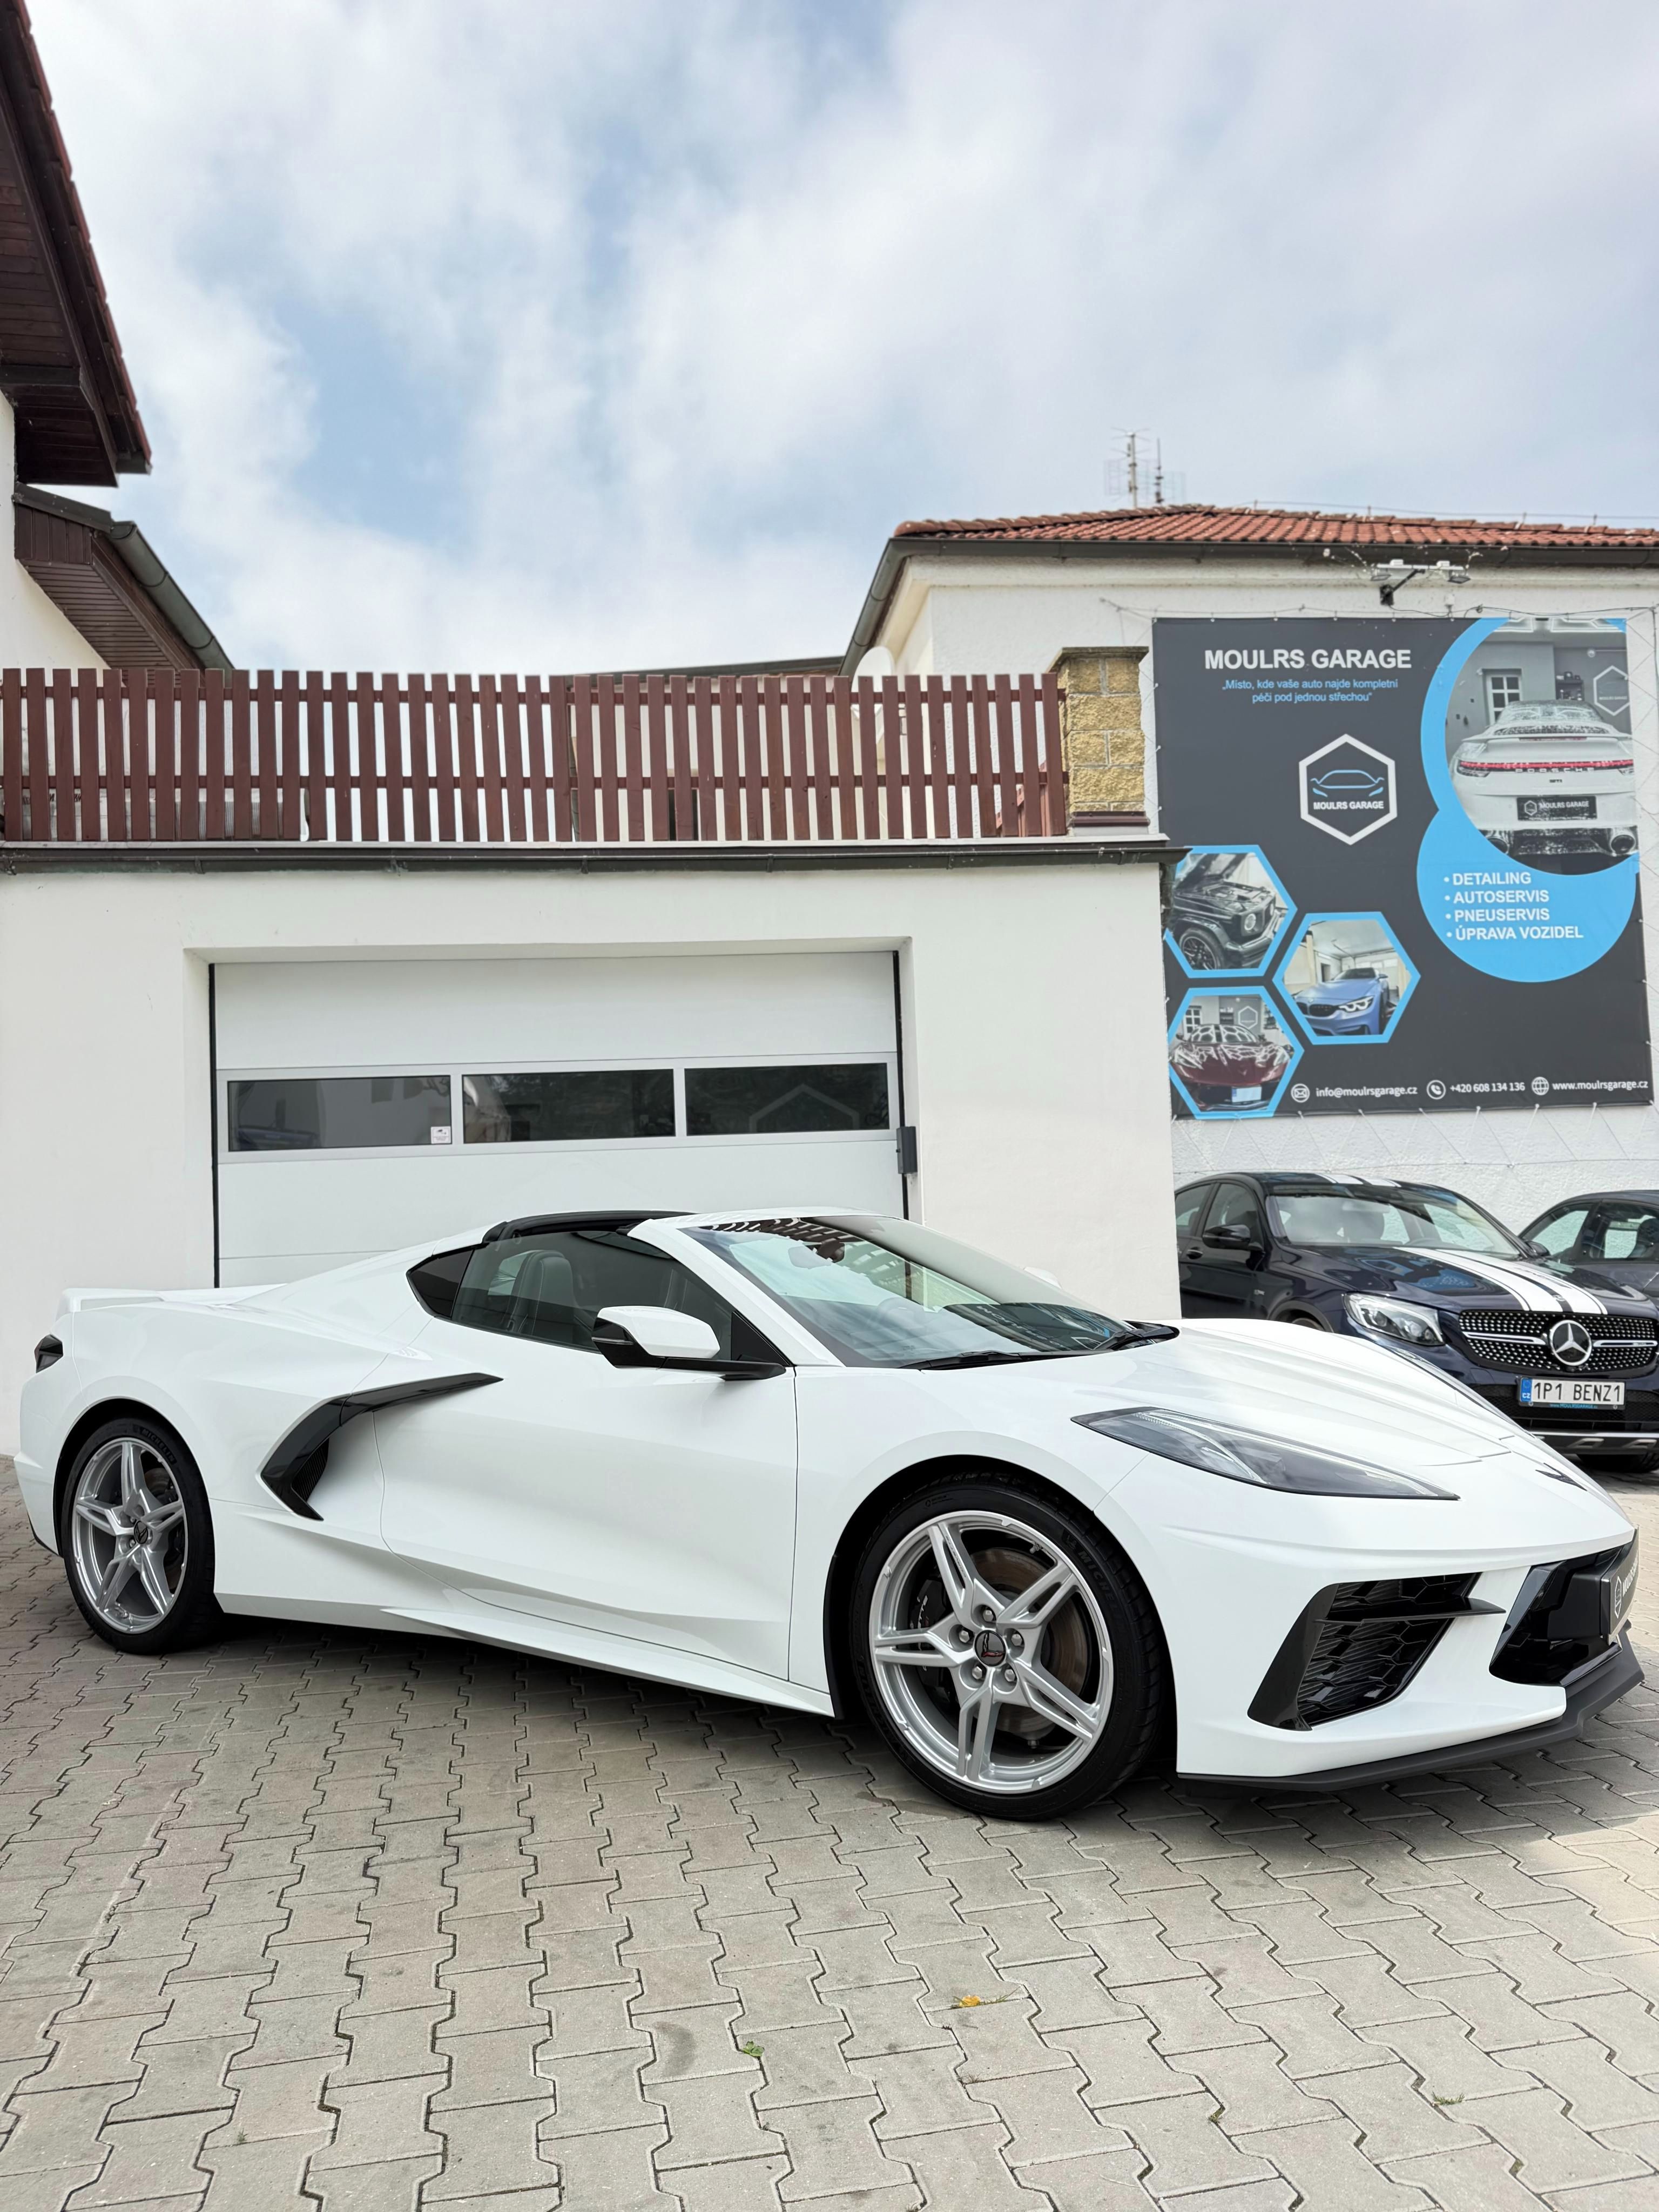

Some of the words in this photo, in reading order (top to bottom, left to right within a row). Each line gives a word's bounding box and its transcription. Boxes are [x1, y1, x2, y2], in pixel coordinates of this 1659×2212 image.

[1205, 650, 1305, 669] MOULRS
[1311, 649, 1412, 669] GARAGE
[1257, 679, 1274, 689] kde
[1276, 679, 1299, 689] vaše
[1301, 680, 1323, 689] auto
[1325, 679, 1351, 690] najde
[1274, 692, 1292, 704] pod
[1294, 692, 1327, 704] jednou
[1313, 801, 1348, 810] MOULRS
[1349, 801, 1384, 809] GARAGE
[1452, 872, 1532, 886] DETAILING
[1453, 890, 1549, 903] AUTOSERVIS
[1454, 908, 1550, 922] PNEUSERVIS
[1455, 925, 1516, 941] ÚPRAVA
[1519, 926, 1583, 939] VOZIDEL
[1316, 1086, 1418, 1098] info@moulrsgarage.cz
[1449, 1084, 1472, 1092] +420
[1473, 1083, 1490, 1092] 608
[1492, 1083, 1507, 1091] 134
[1509, 1082, 1525, 1091] 136
[1552, 1081, 1649, 1091] www.moulrsgarage.cz
[1534, 1382, 1562, 1400] 1P1
[1573, 1384, 1620, 1402] BENZ1
